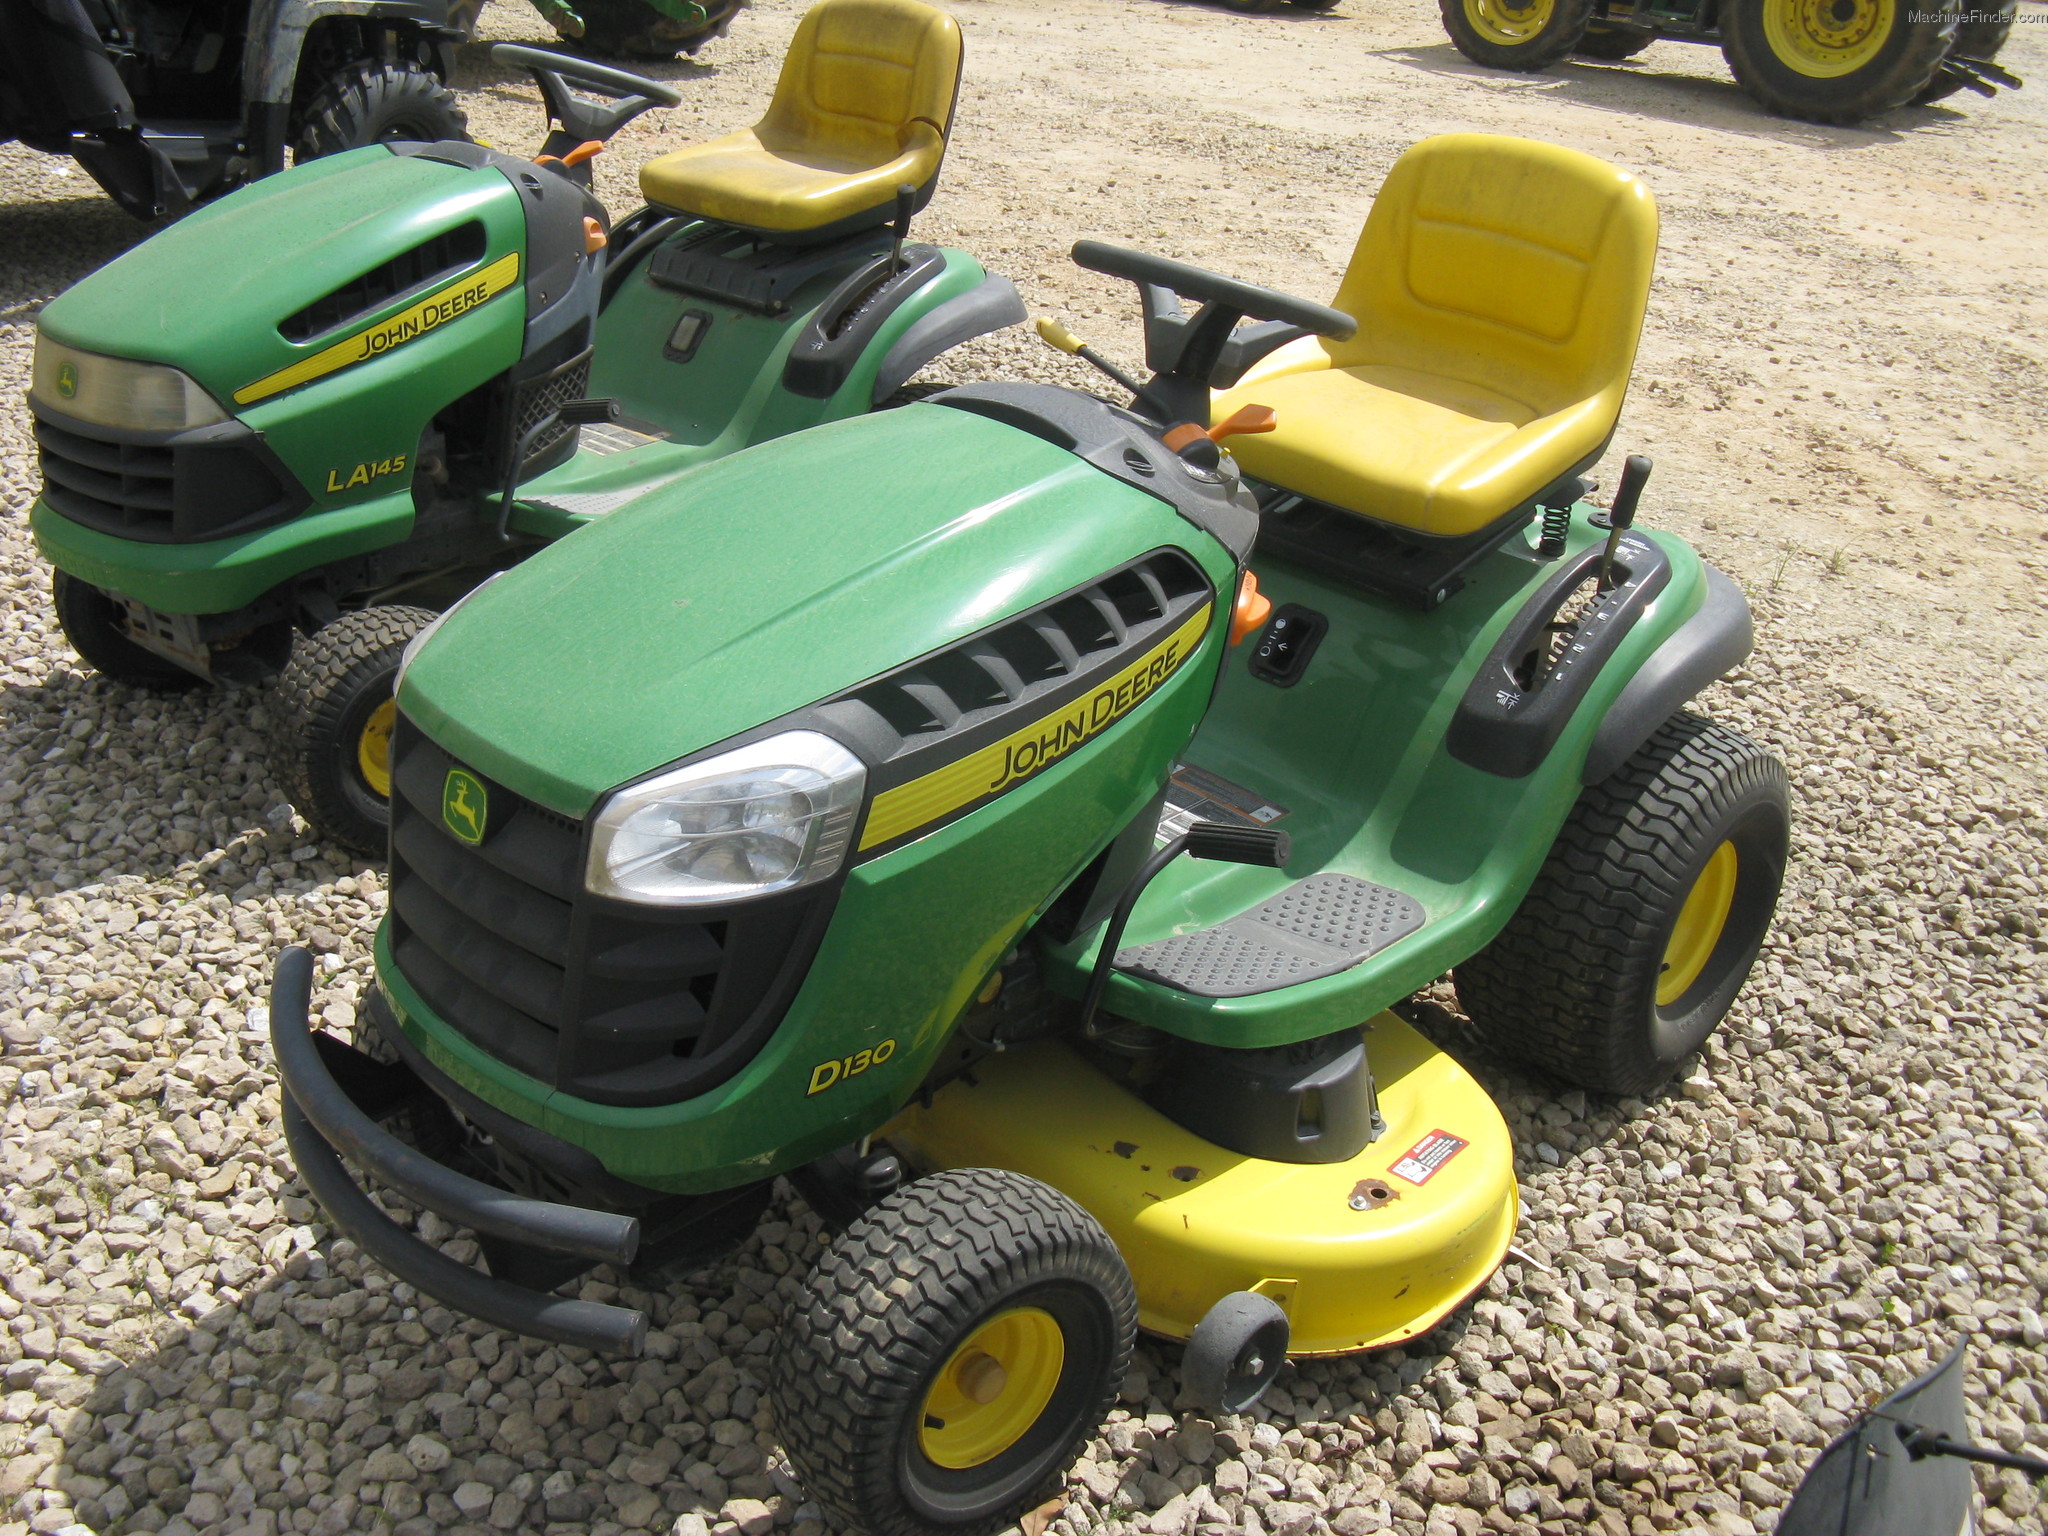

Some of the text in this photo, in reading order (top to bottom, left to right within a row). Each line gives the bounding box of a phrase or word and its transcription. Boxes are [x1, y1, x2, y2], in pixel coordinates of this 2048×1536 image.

[358, 281, 488, 359] JOHN DEERE
[326, 455, 406, 493] LA145
[990, 638, 1181, 790] JOHN DEERE
[806, 1038, 896, 1096] D130
